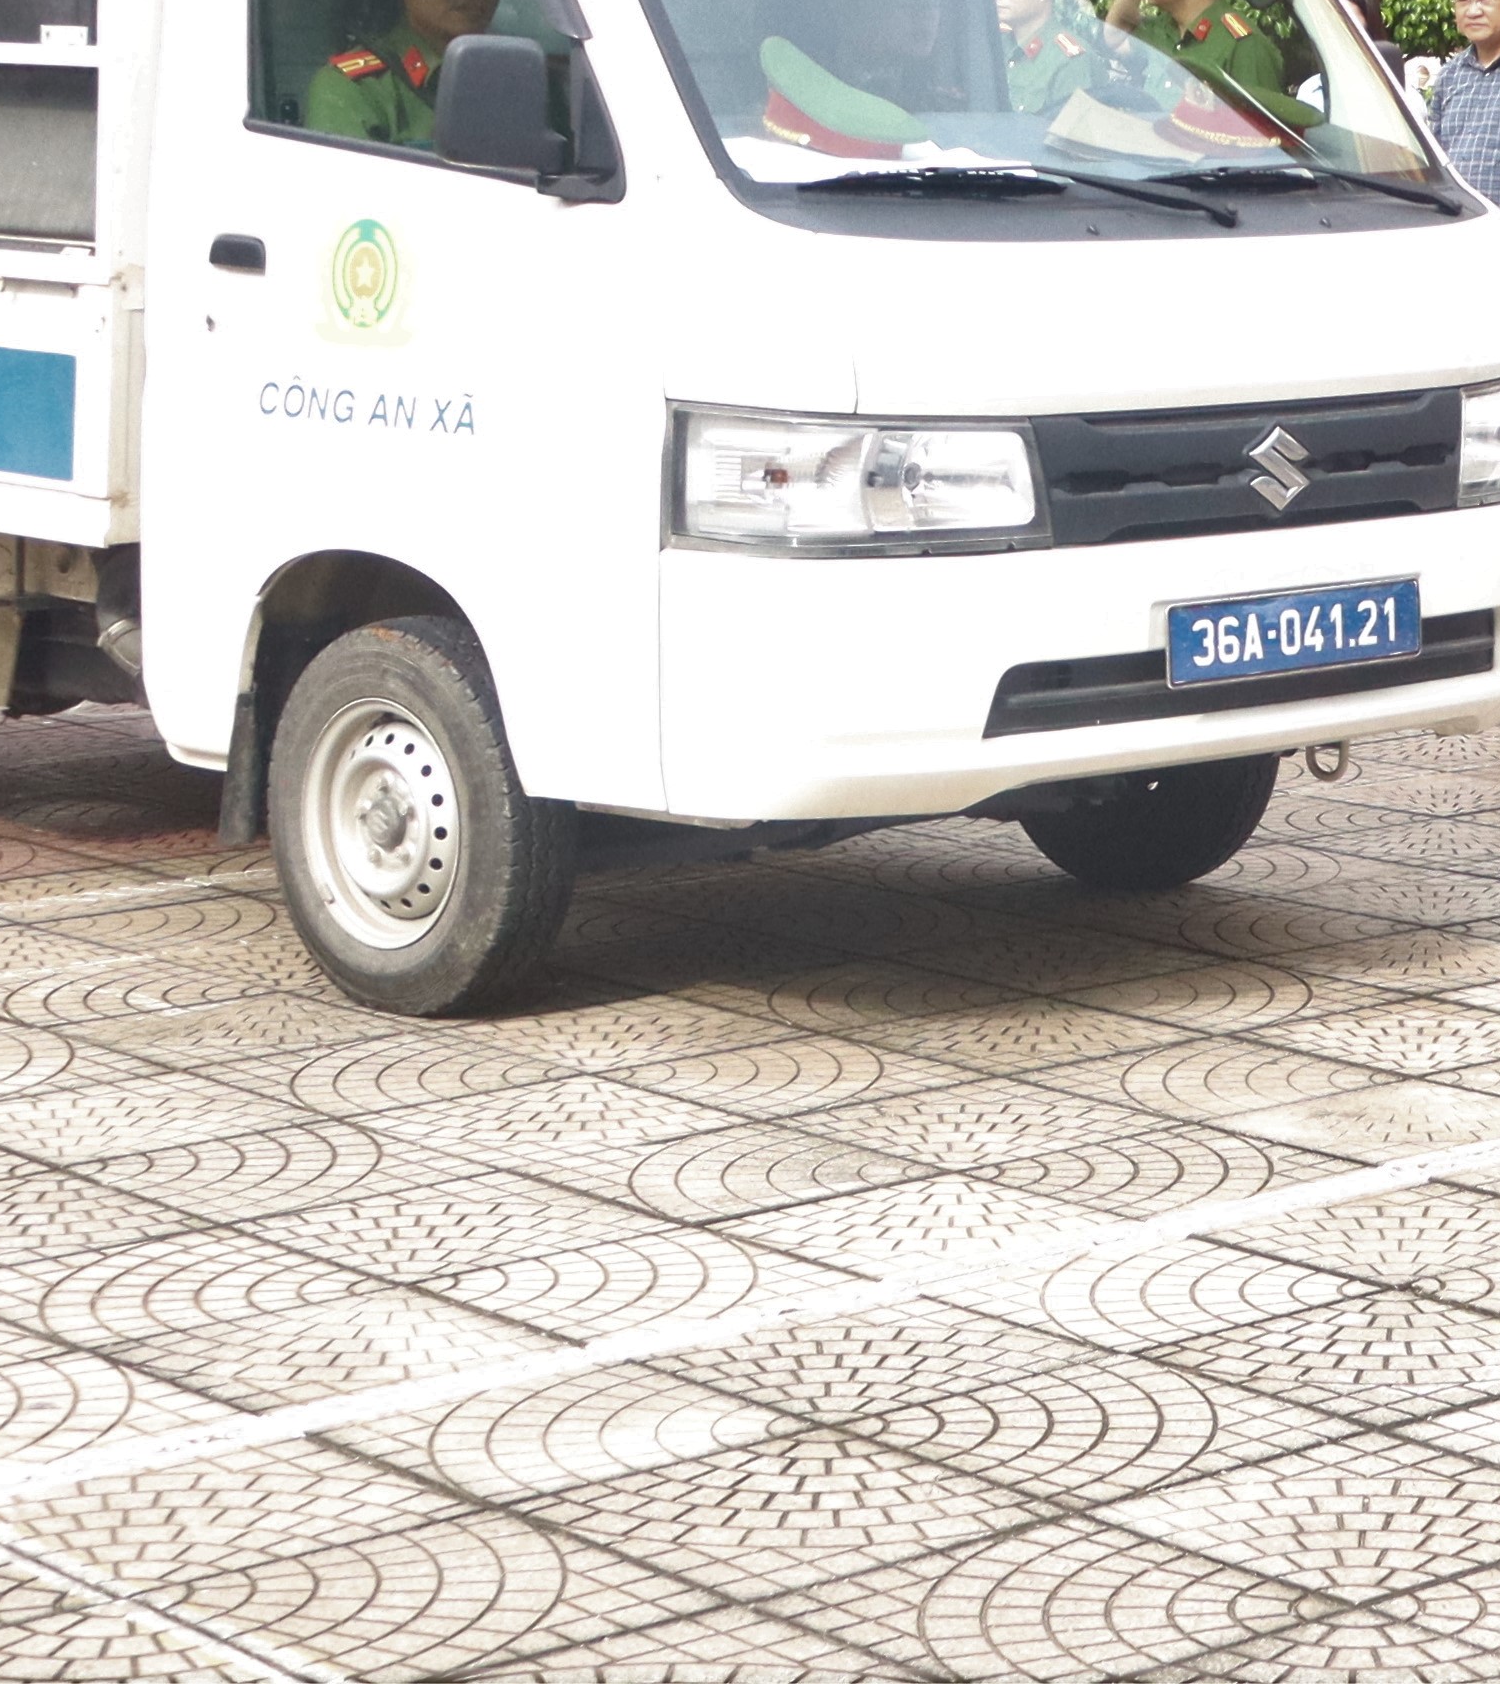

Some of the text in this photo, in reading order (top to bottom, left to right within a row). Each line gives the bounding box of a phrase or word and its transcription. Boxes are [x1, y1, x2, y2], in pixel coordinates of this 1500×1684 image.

[258, 376, 475, 436] CÔNG AN XÃ
